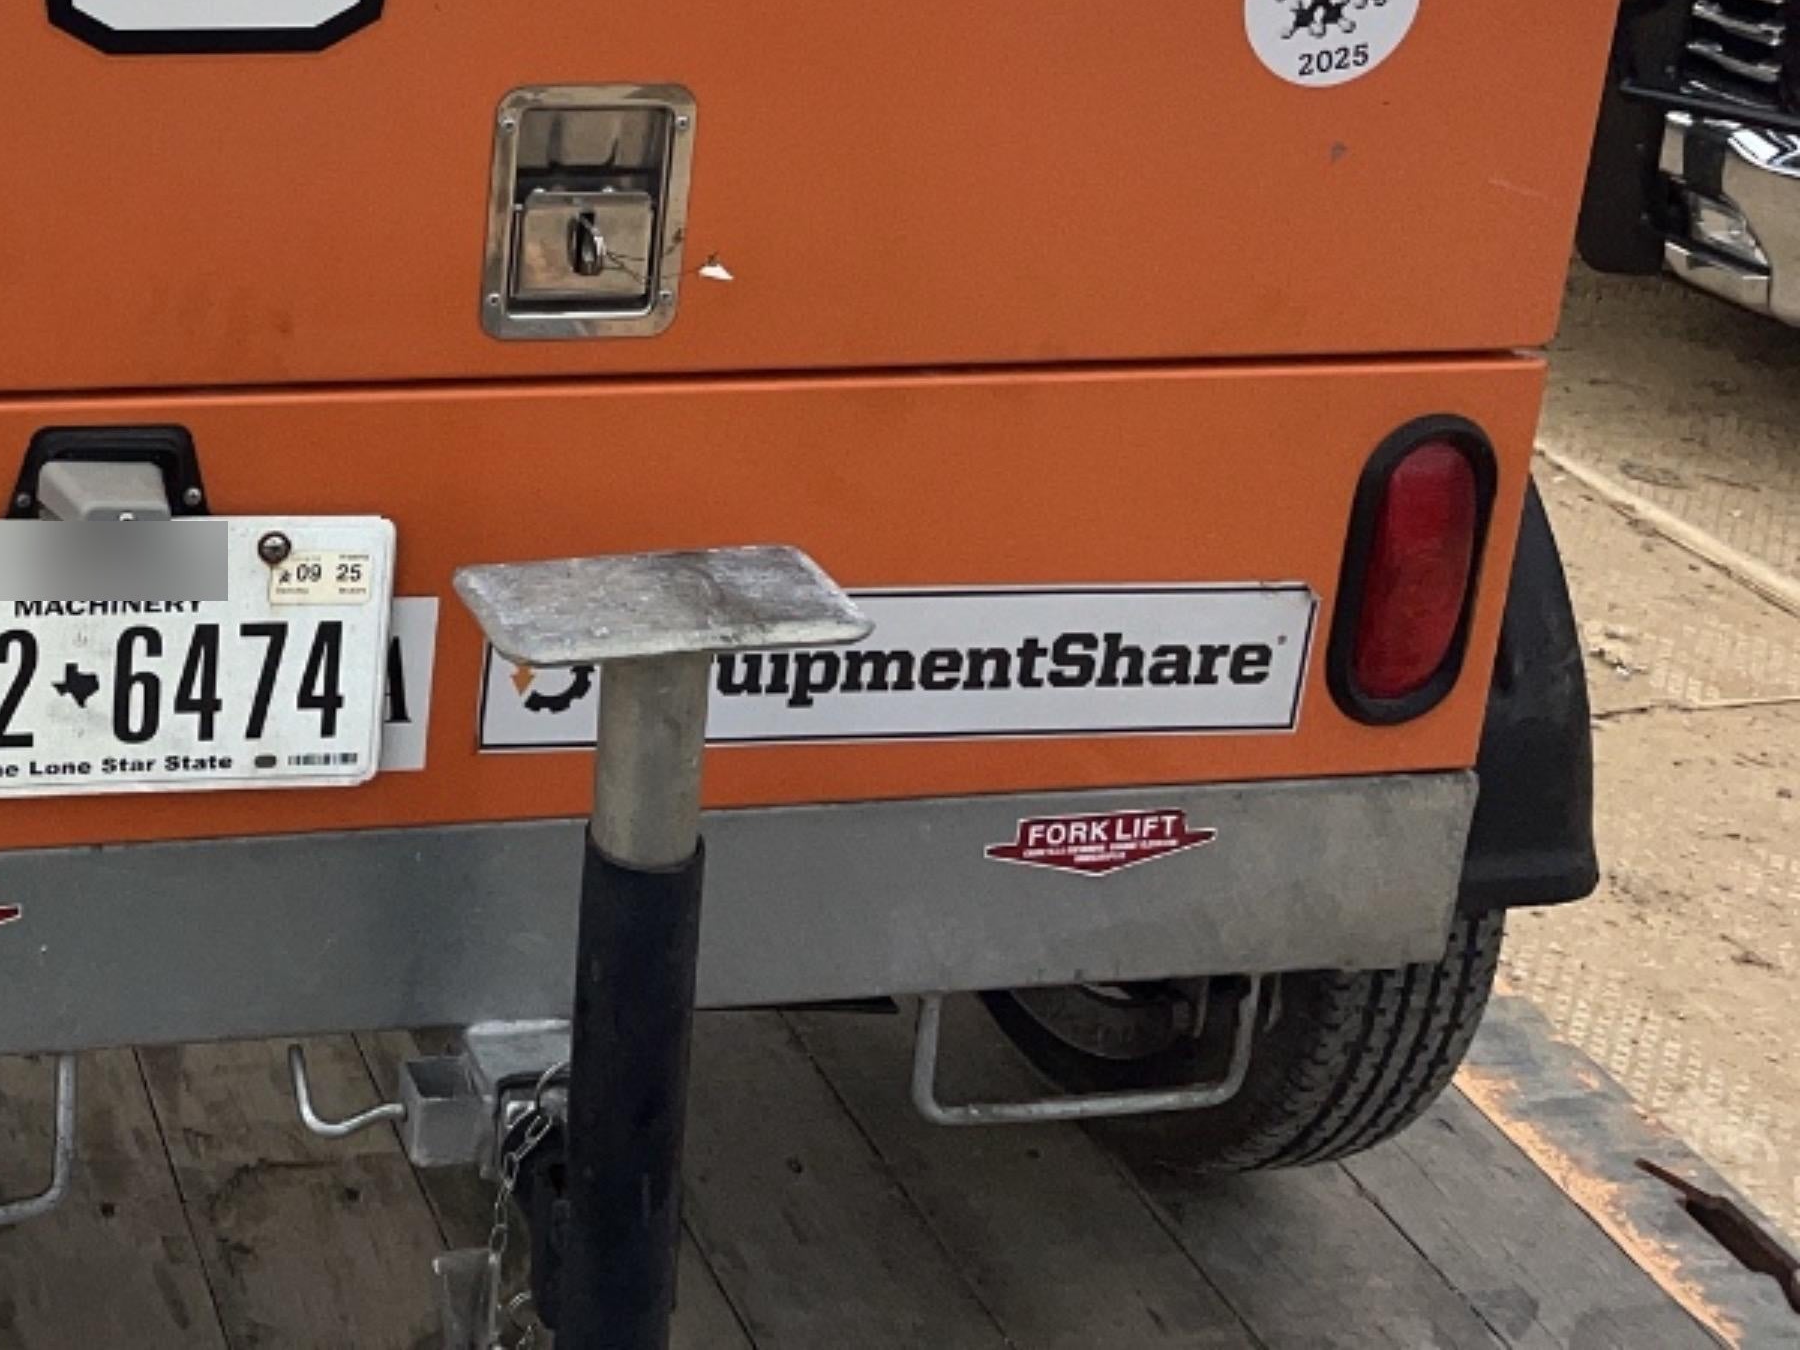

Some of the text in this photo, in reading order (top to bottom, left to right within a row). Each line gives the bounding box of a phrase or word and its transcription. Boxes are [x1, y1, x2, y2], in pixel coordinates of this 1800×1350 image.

[1297, 44, 1370, 76] 2025
[296, 562, 363, 582] 09 25
[13, 600, 203, 618] MACHINERY
[715, 632, 1273, 708] uipmentShare
[28, 758, 92, 777] Lone
[101, 755, 156, 773] Star
[163, 753, 234, 771] State
[1027, 814, 1178, 847] FORK LIFT
